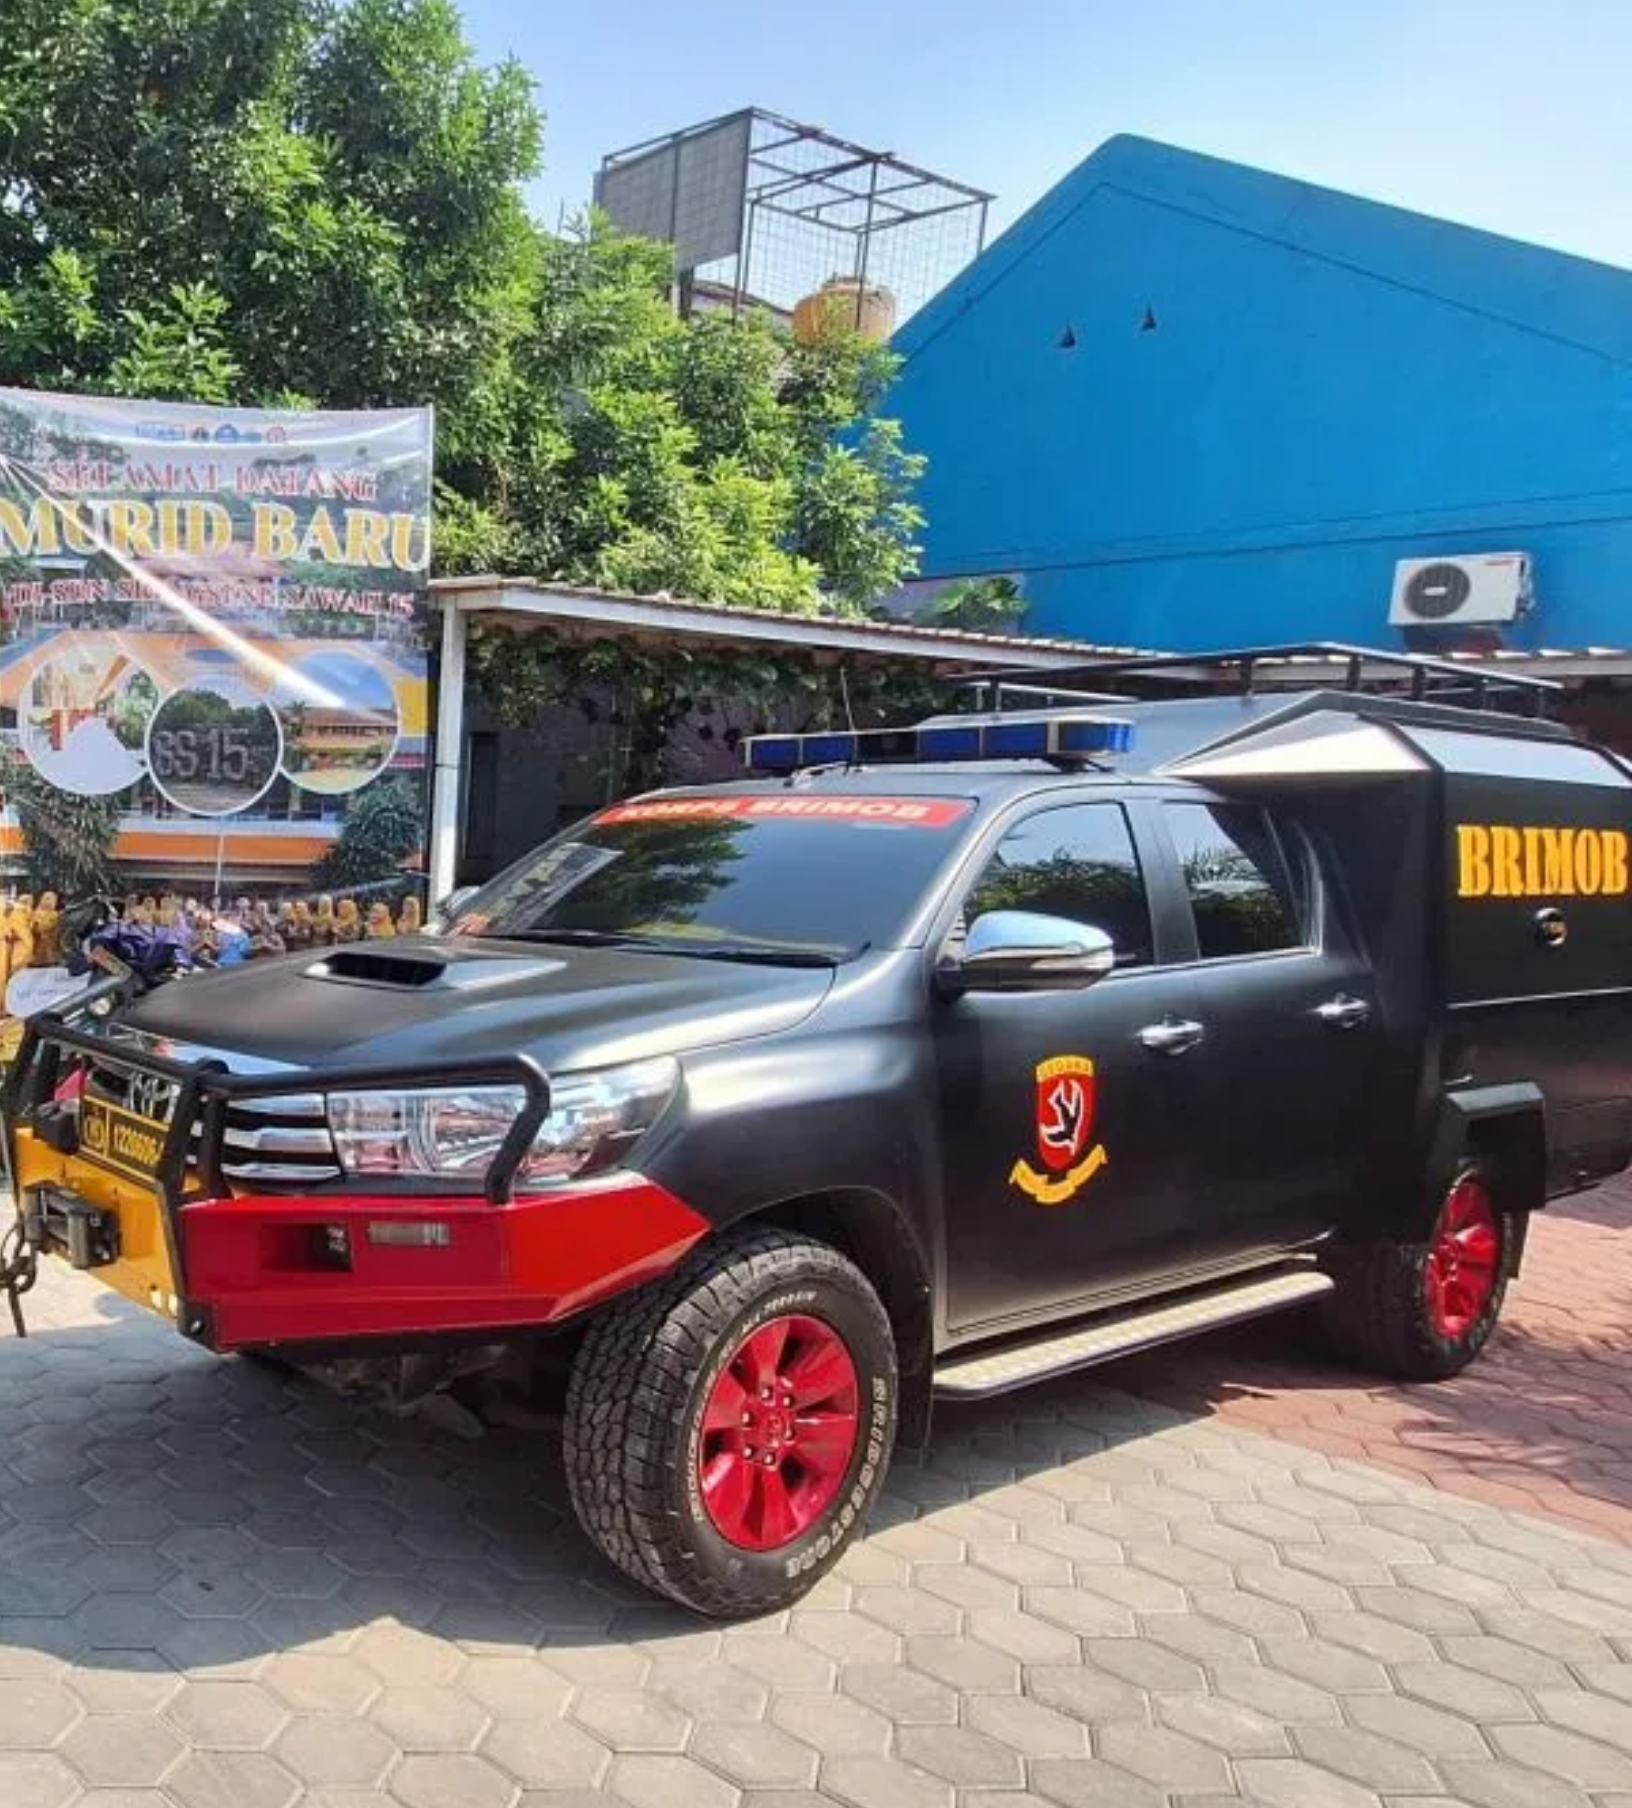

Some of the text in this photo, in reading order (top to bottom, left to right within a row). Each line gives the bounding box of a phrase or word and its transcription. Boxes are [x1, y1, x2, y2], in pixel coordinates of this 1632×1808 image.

[49, 459, 378, 500] SELAMAT DATANG
[252, 504, 431, 573] BARU
[206, 727, 249, 780] 15
[747, 800, 930, 821] BRIMOB
[1456, 824, 1630, 897] BRIMOB
